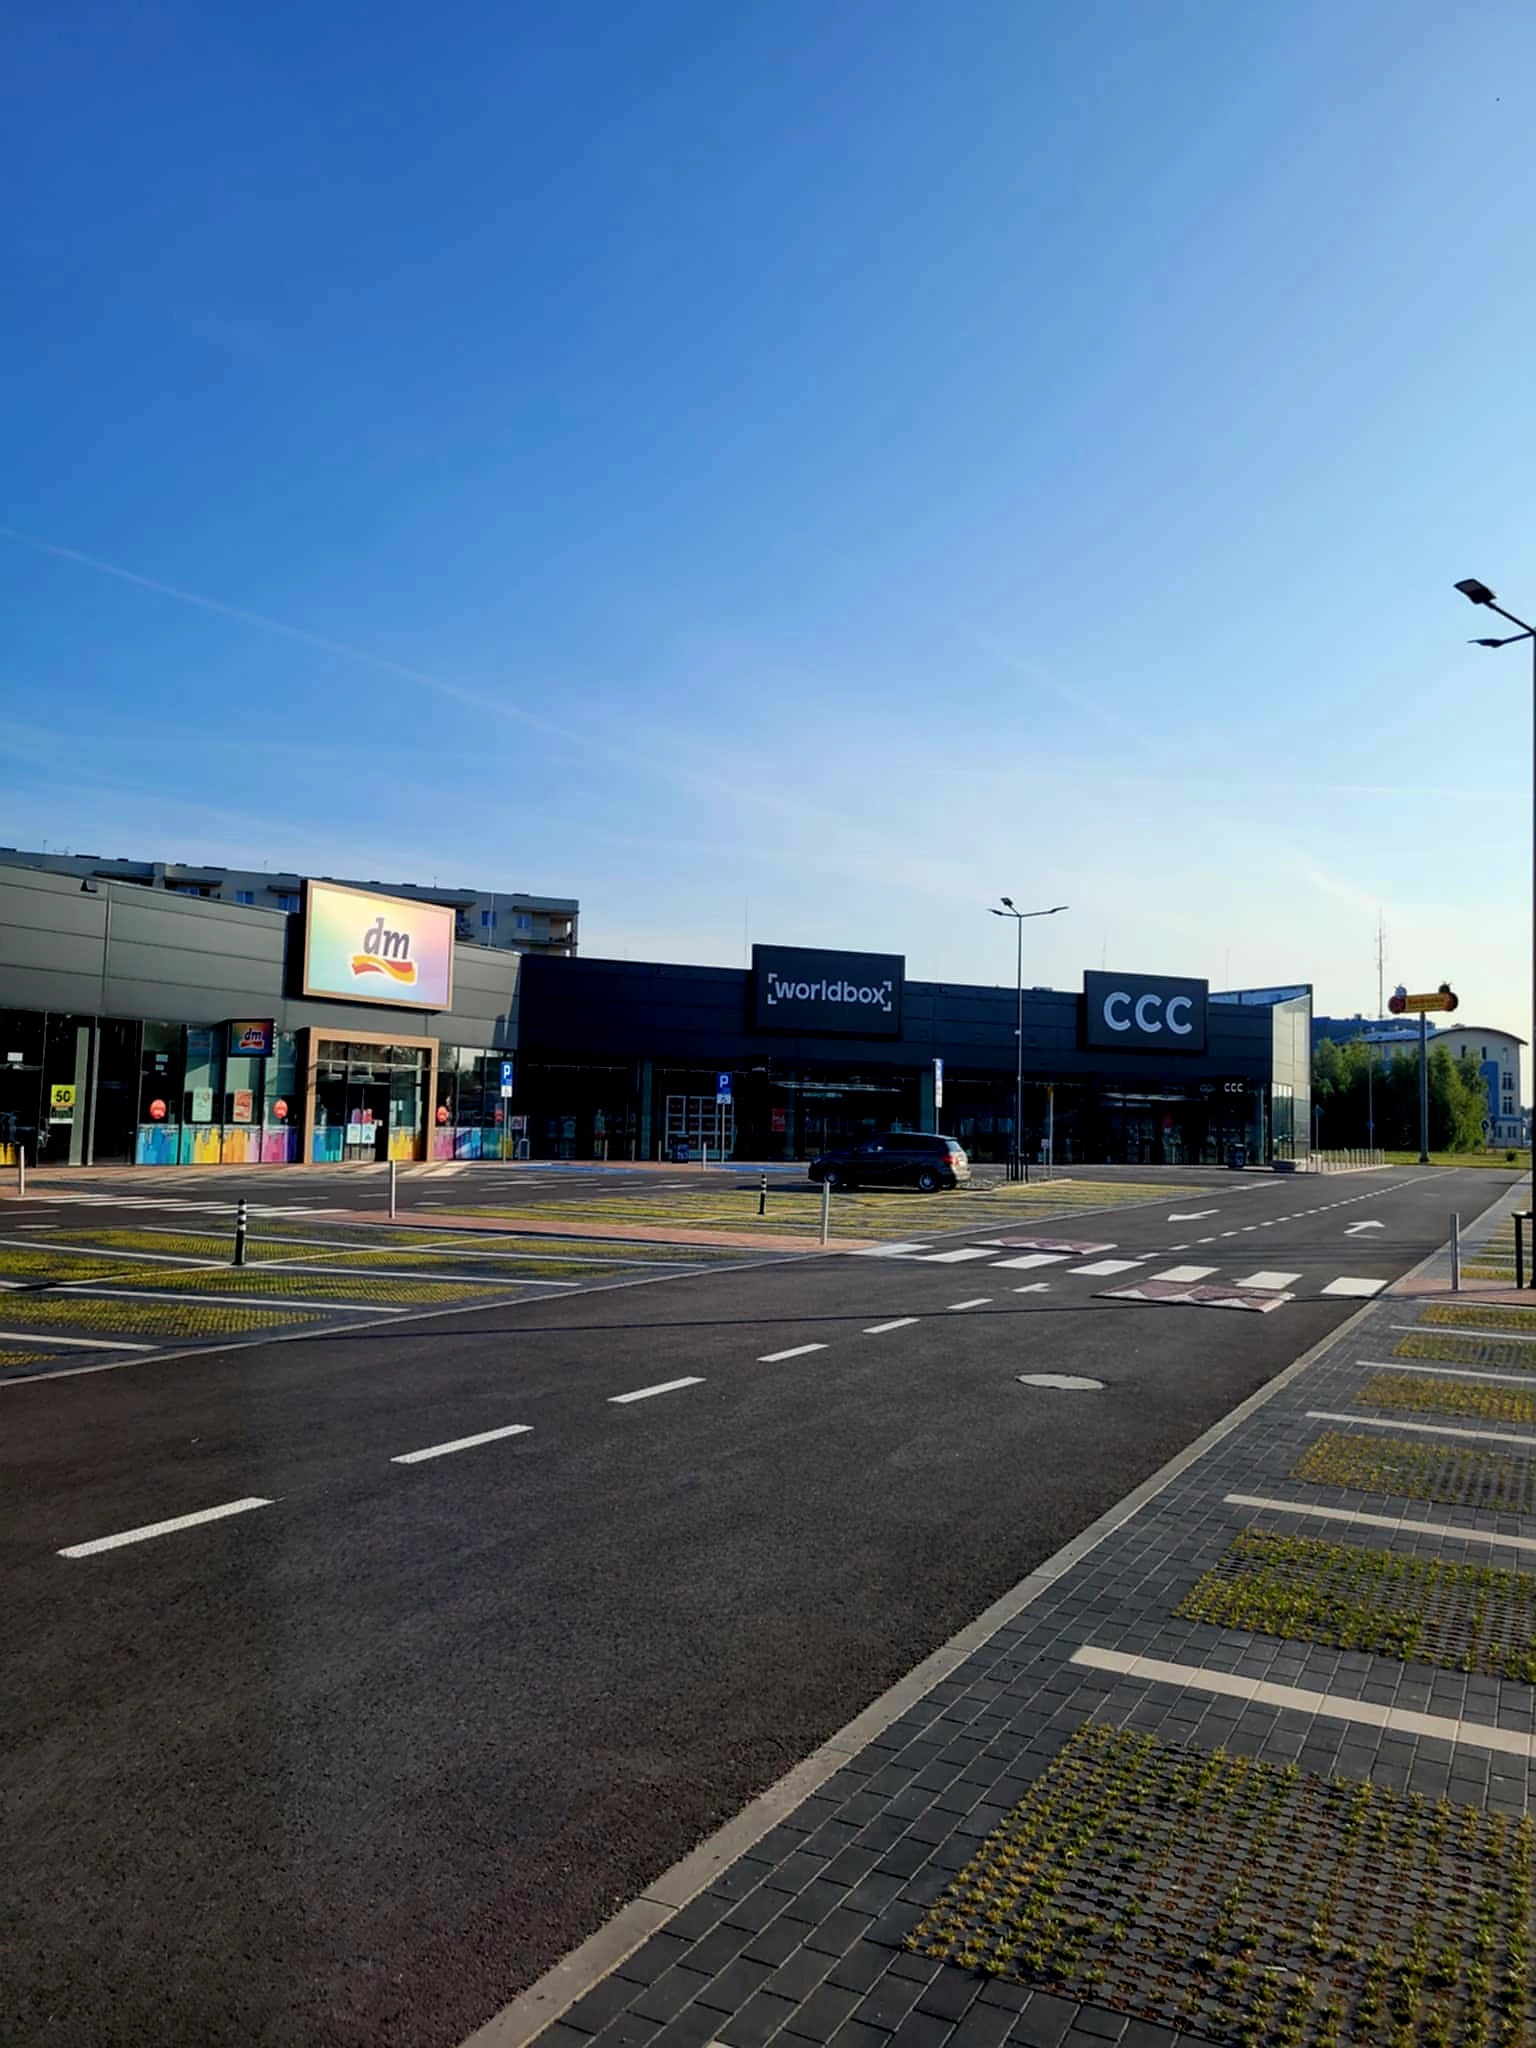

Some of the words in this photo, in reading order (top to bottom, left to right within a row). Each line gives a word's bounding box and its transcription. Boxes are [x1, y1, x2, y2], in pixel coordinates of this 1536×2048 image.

[364, 918, 409, 960] dm
[775, 979, 887, 1006] worldbox
[1103, 992, 1193, 1034] CCC
[245, 1028, 262, 1041] dm
[504, 1065, 511, 1079] P
[720, 1075, 728, 1088] P
[1224, 1082, 1244, 1093] CCC
